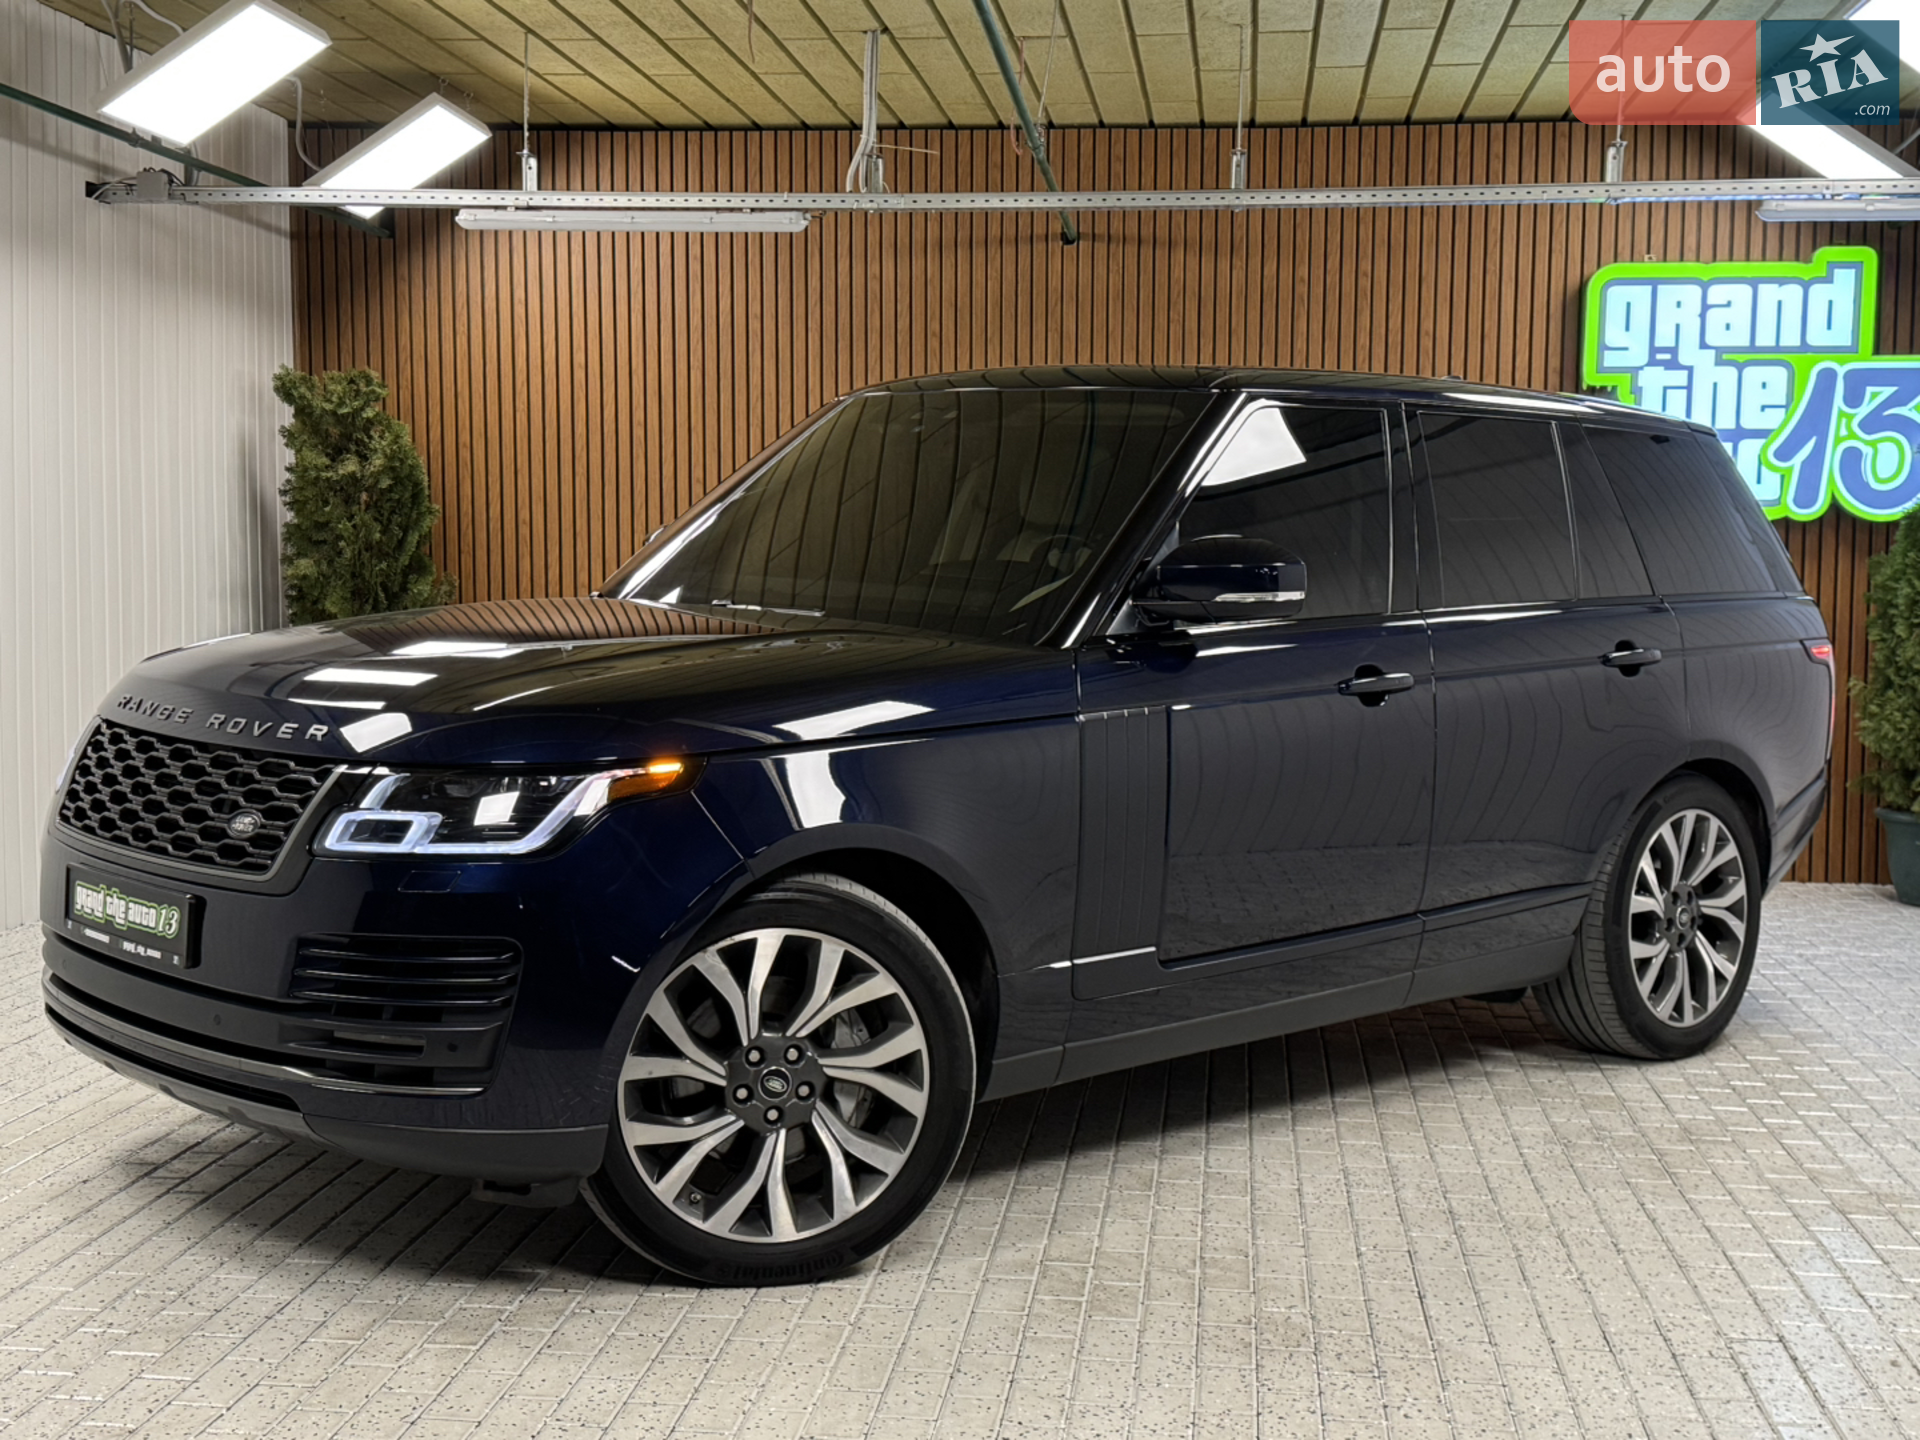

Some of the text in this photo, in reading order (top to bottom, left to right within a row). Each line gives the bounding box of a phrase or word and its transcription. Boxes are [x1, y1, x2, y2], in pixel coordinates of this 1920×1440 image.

[1638, 349, 1788, 430] the
[1767, 361, 1920, 514] 13
[117, 694, 329, 742] RANGE ROVER
[158, 908, 179, 935] 13
